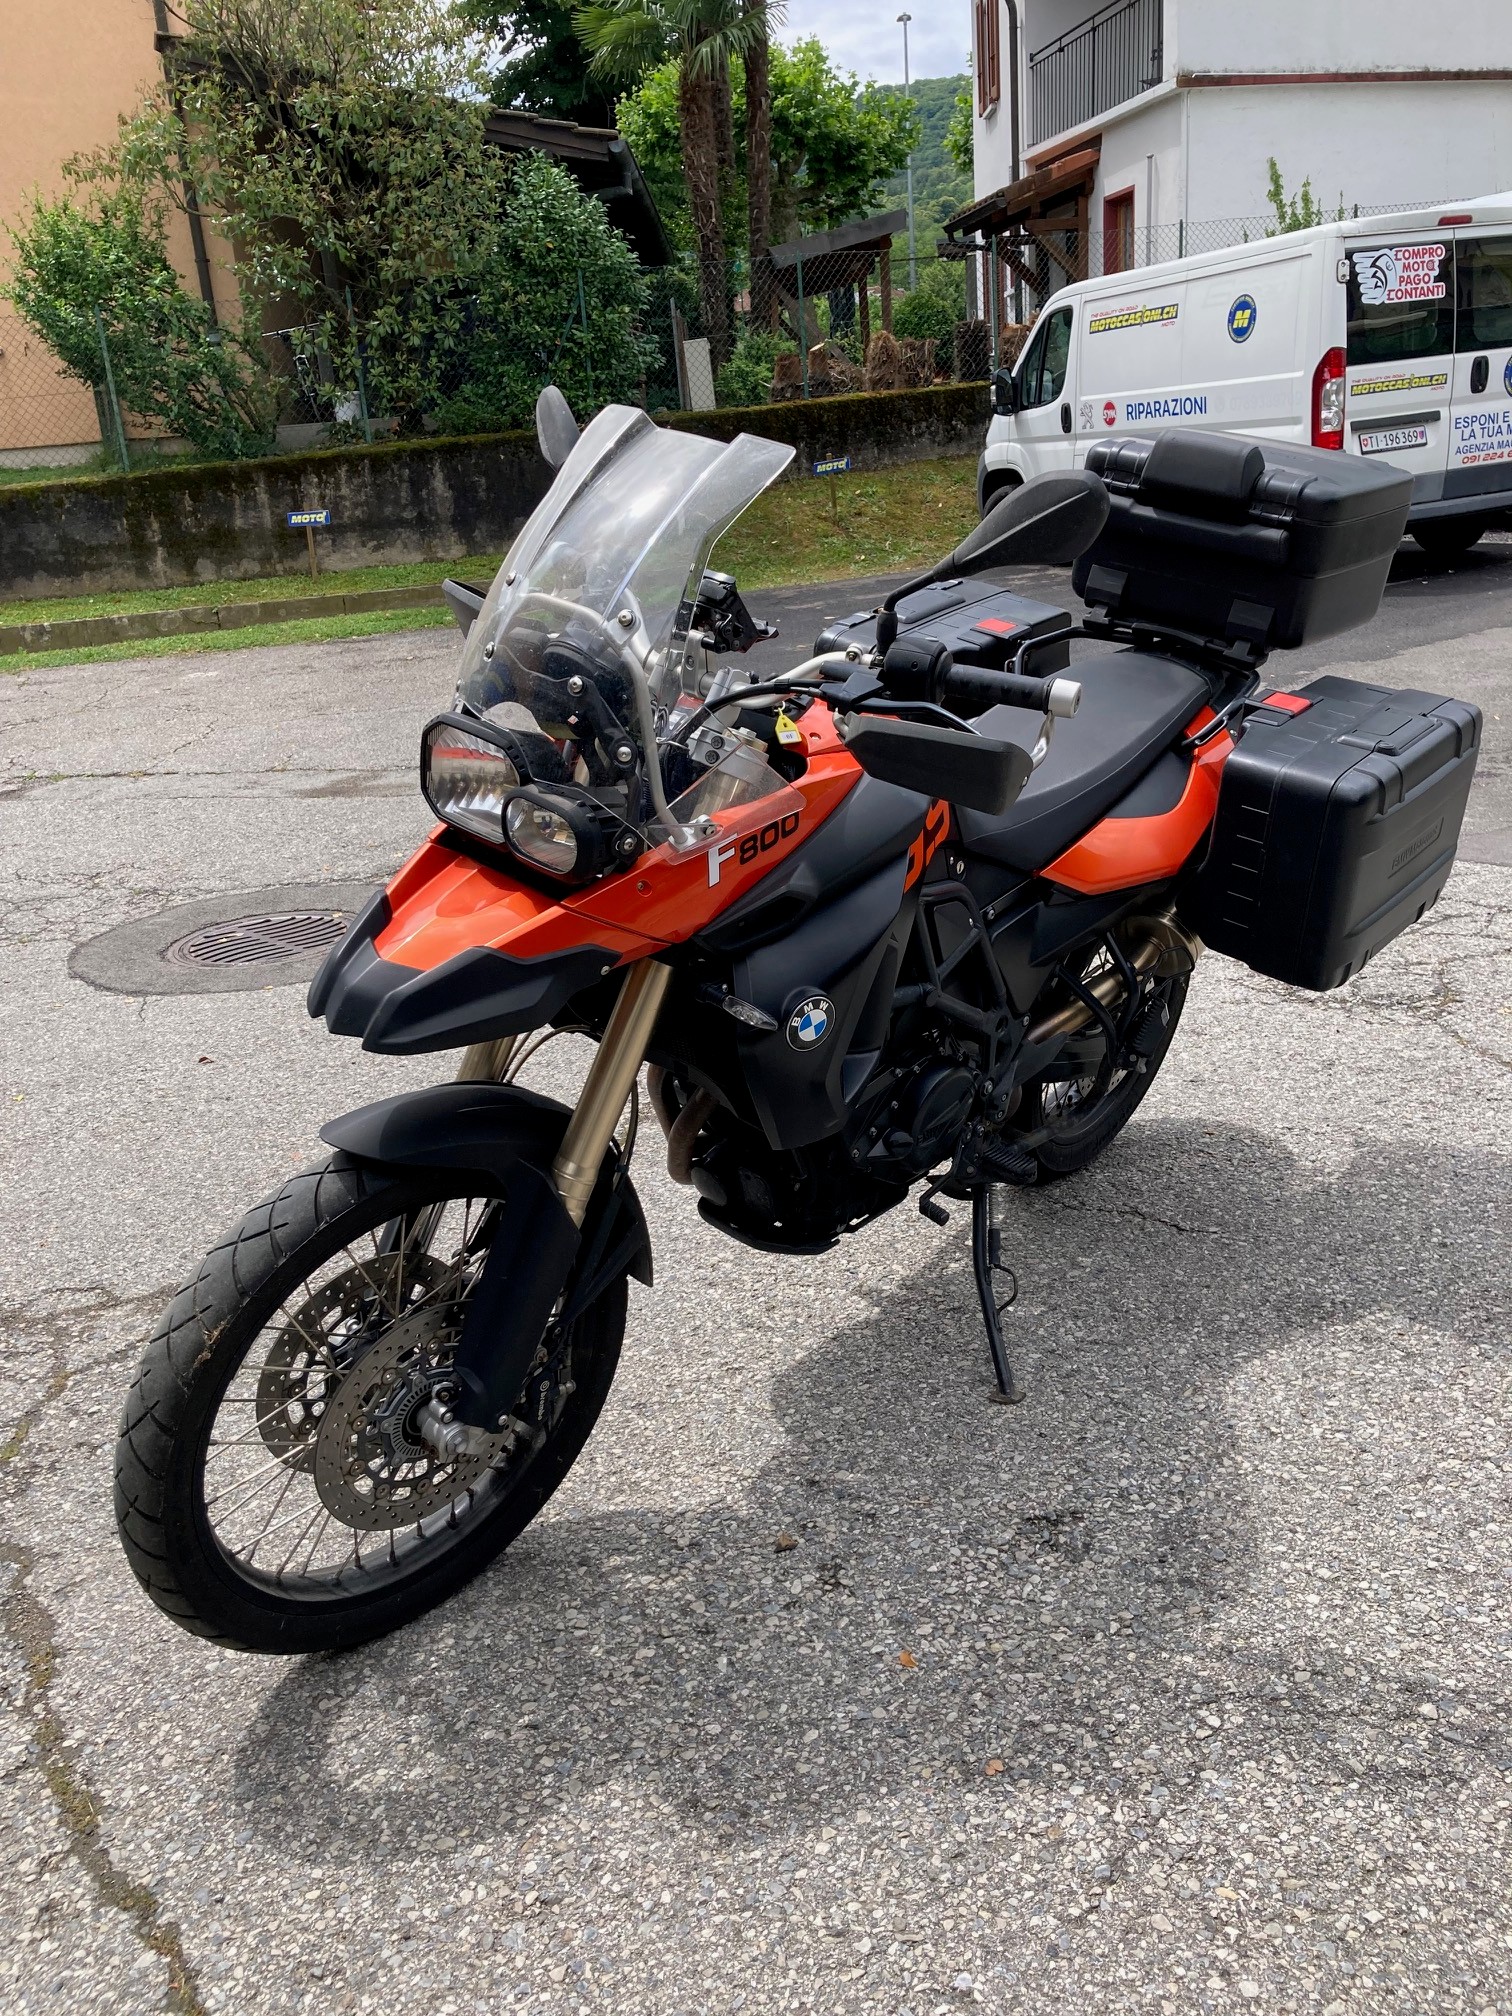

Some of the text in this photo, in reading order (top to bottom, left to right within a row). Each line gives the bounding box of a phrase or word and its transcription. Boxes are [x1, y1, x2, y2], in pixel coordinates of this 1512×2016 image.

[1394, 246, 1444, 260] COMPRO
[1398, 273, 1431, 287] PAGO
[1386, 284, 1444, 301] CONTANTI
[1126, 396, 1207, 421] RIPARAZIONI
[1454, 410, 1510, 430] ESPONI E
[1461, 428, 1477, 441] LA
[1480, 424, 1504, 439] TUA
[1455, 441, 1495, 455] AGENZIA
[1461, 454, 1480, 464] 091
[1482, 450, 1504, 461] 224
[291, 512, 325, 524] MOTO
[790, 1000, 829, 1027] BMW
